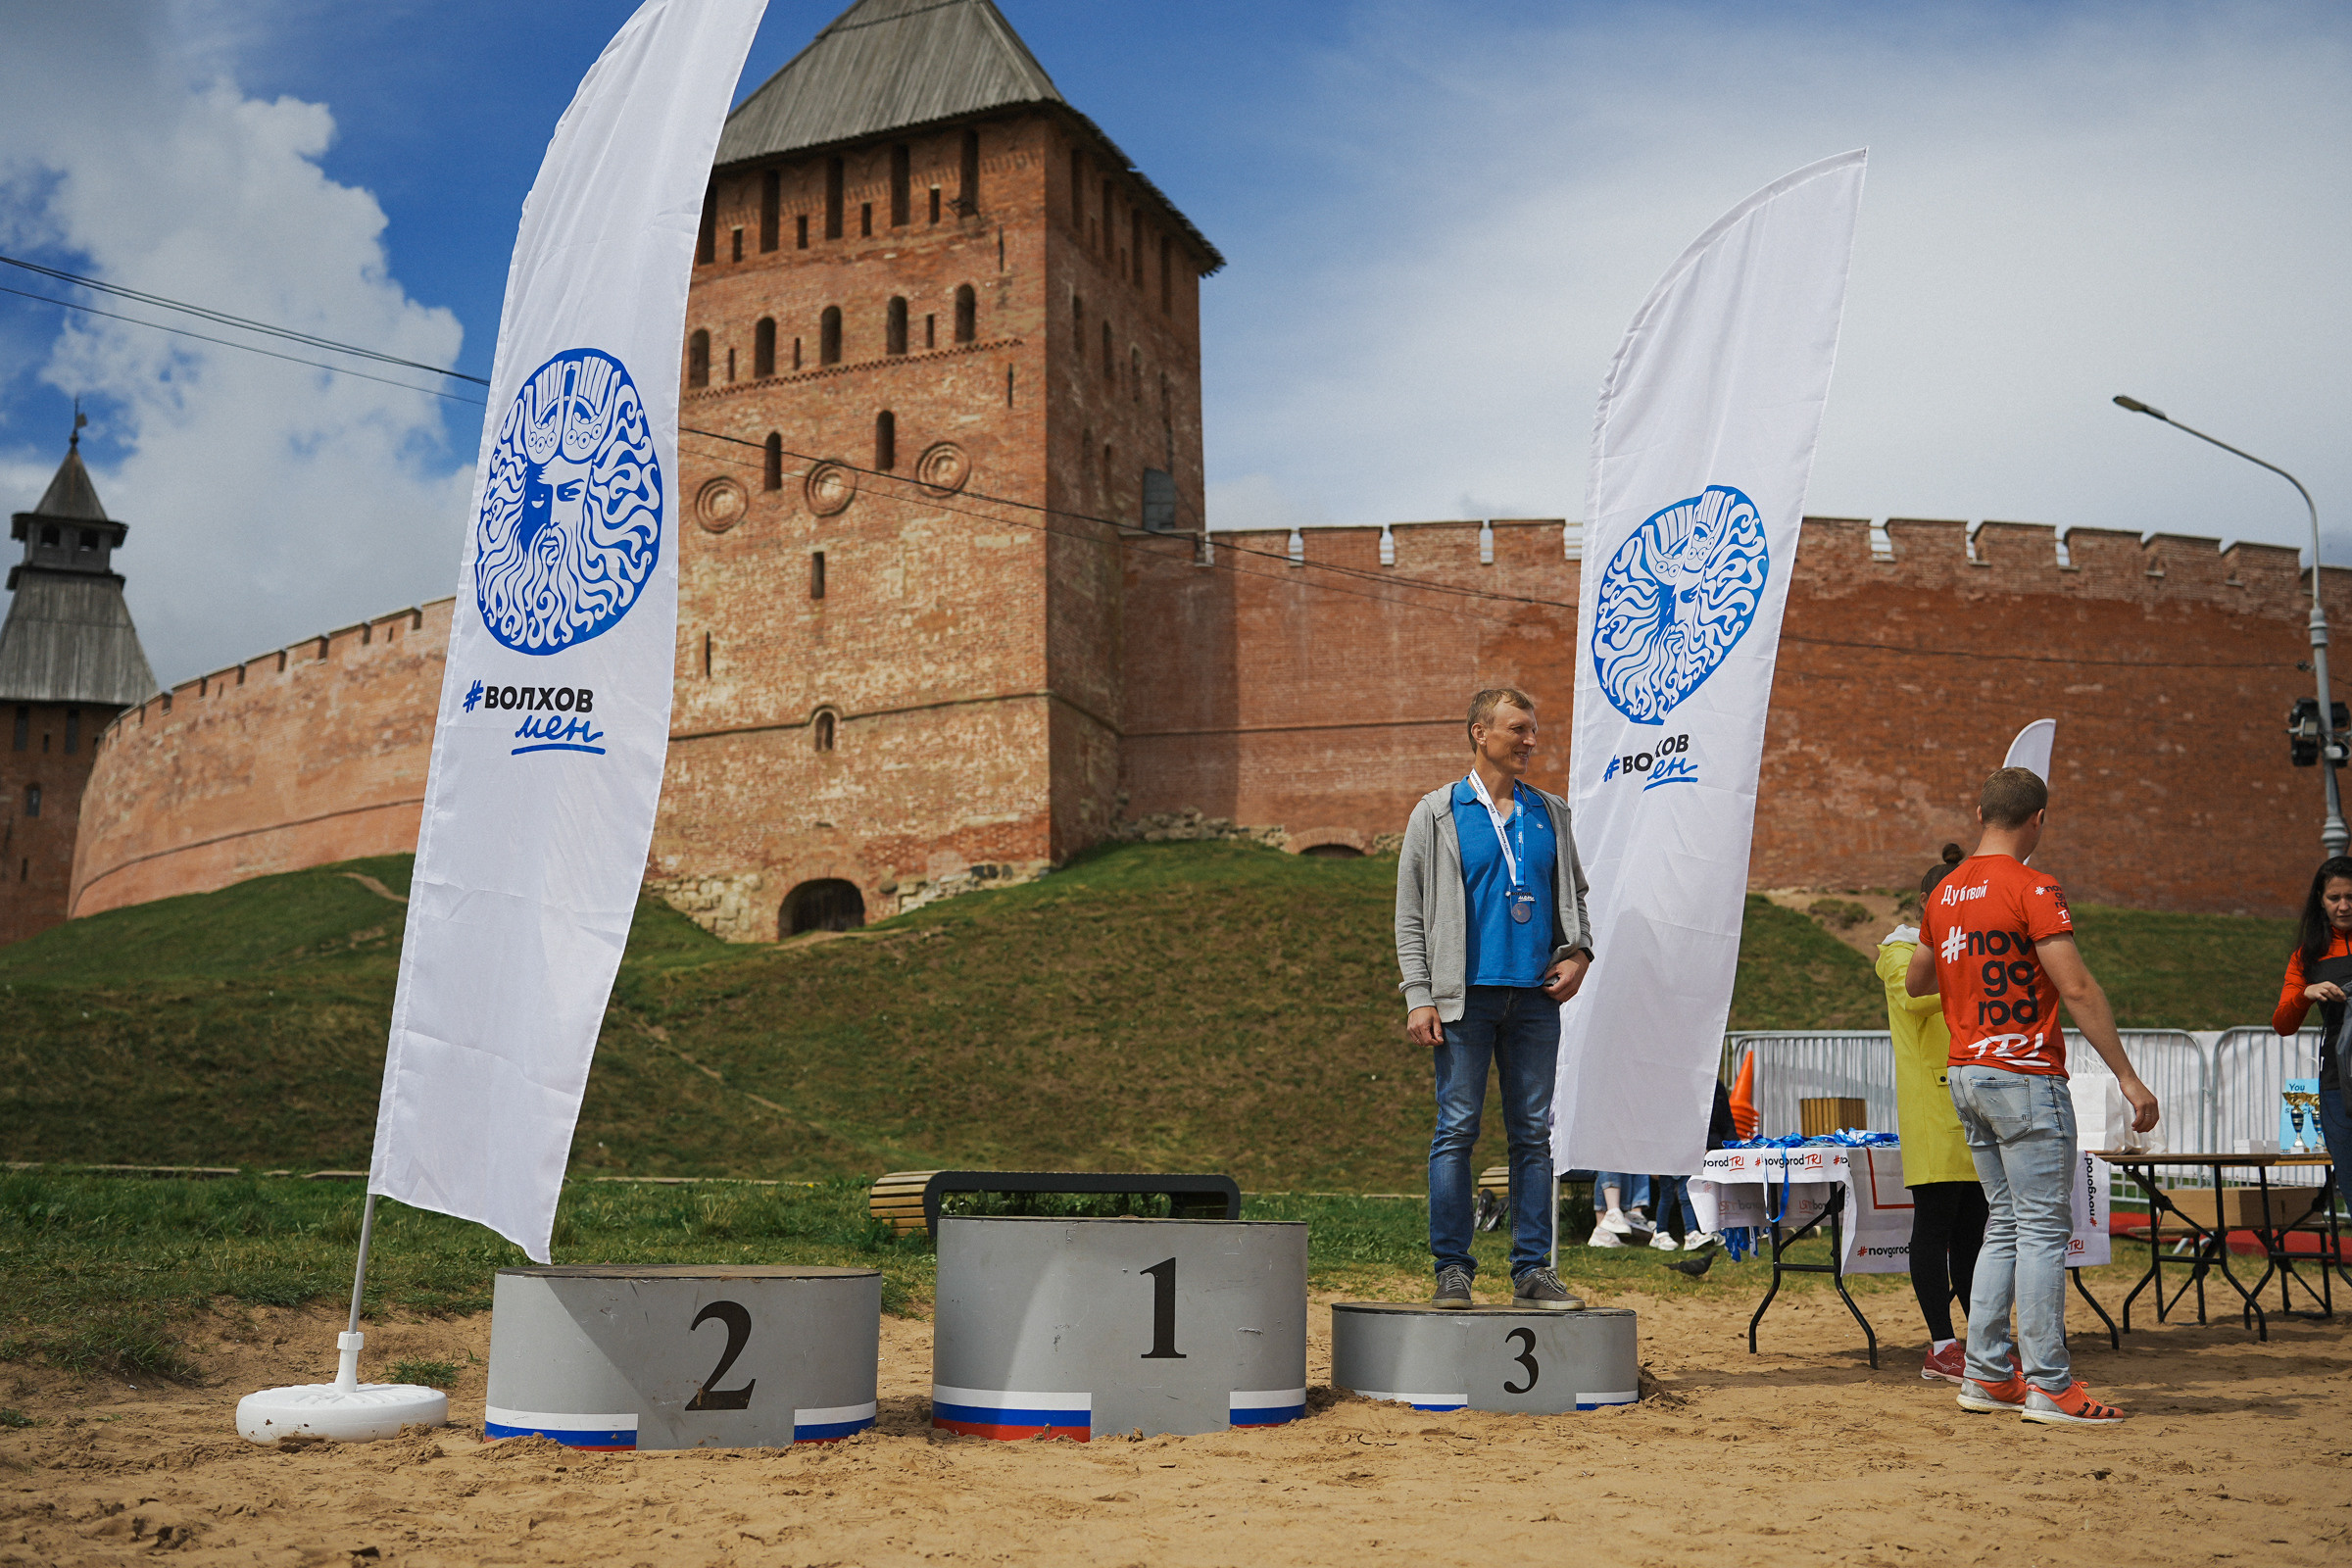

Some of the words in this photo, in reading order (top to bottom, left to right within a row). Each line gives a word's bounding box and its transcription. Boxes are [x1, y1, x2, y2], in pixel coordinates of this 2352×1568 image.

[463, 680, 594, 713] #ВОЛХОВ
[514, 714, 605, 743] мен
[1602, 734, 1690, 782] #ВООВ
[1646, 757, 1698, 782] ен
[1940, 925, 2034, 964] #nov
[1982, 960, 2034, 997] go
[1978, 985, 2038, 1026] rod
[1968, 1032, 2043, 1059] TRI
[2288, 1083, 2306, 1092] You
[2084, 1157, 2097, 1227] #novgorod
[2066, 1239, 2085, 1250] TRI
[1140, 1257, 1187, 1359] 1
[684, 1300, 757, 1412] 2
[1503, 1327, 1540, 1394] 3
